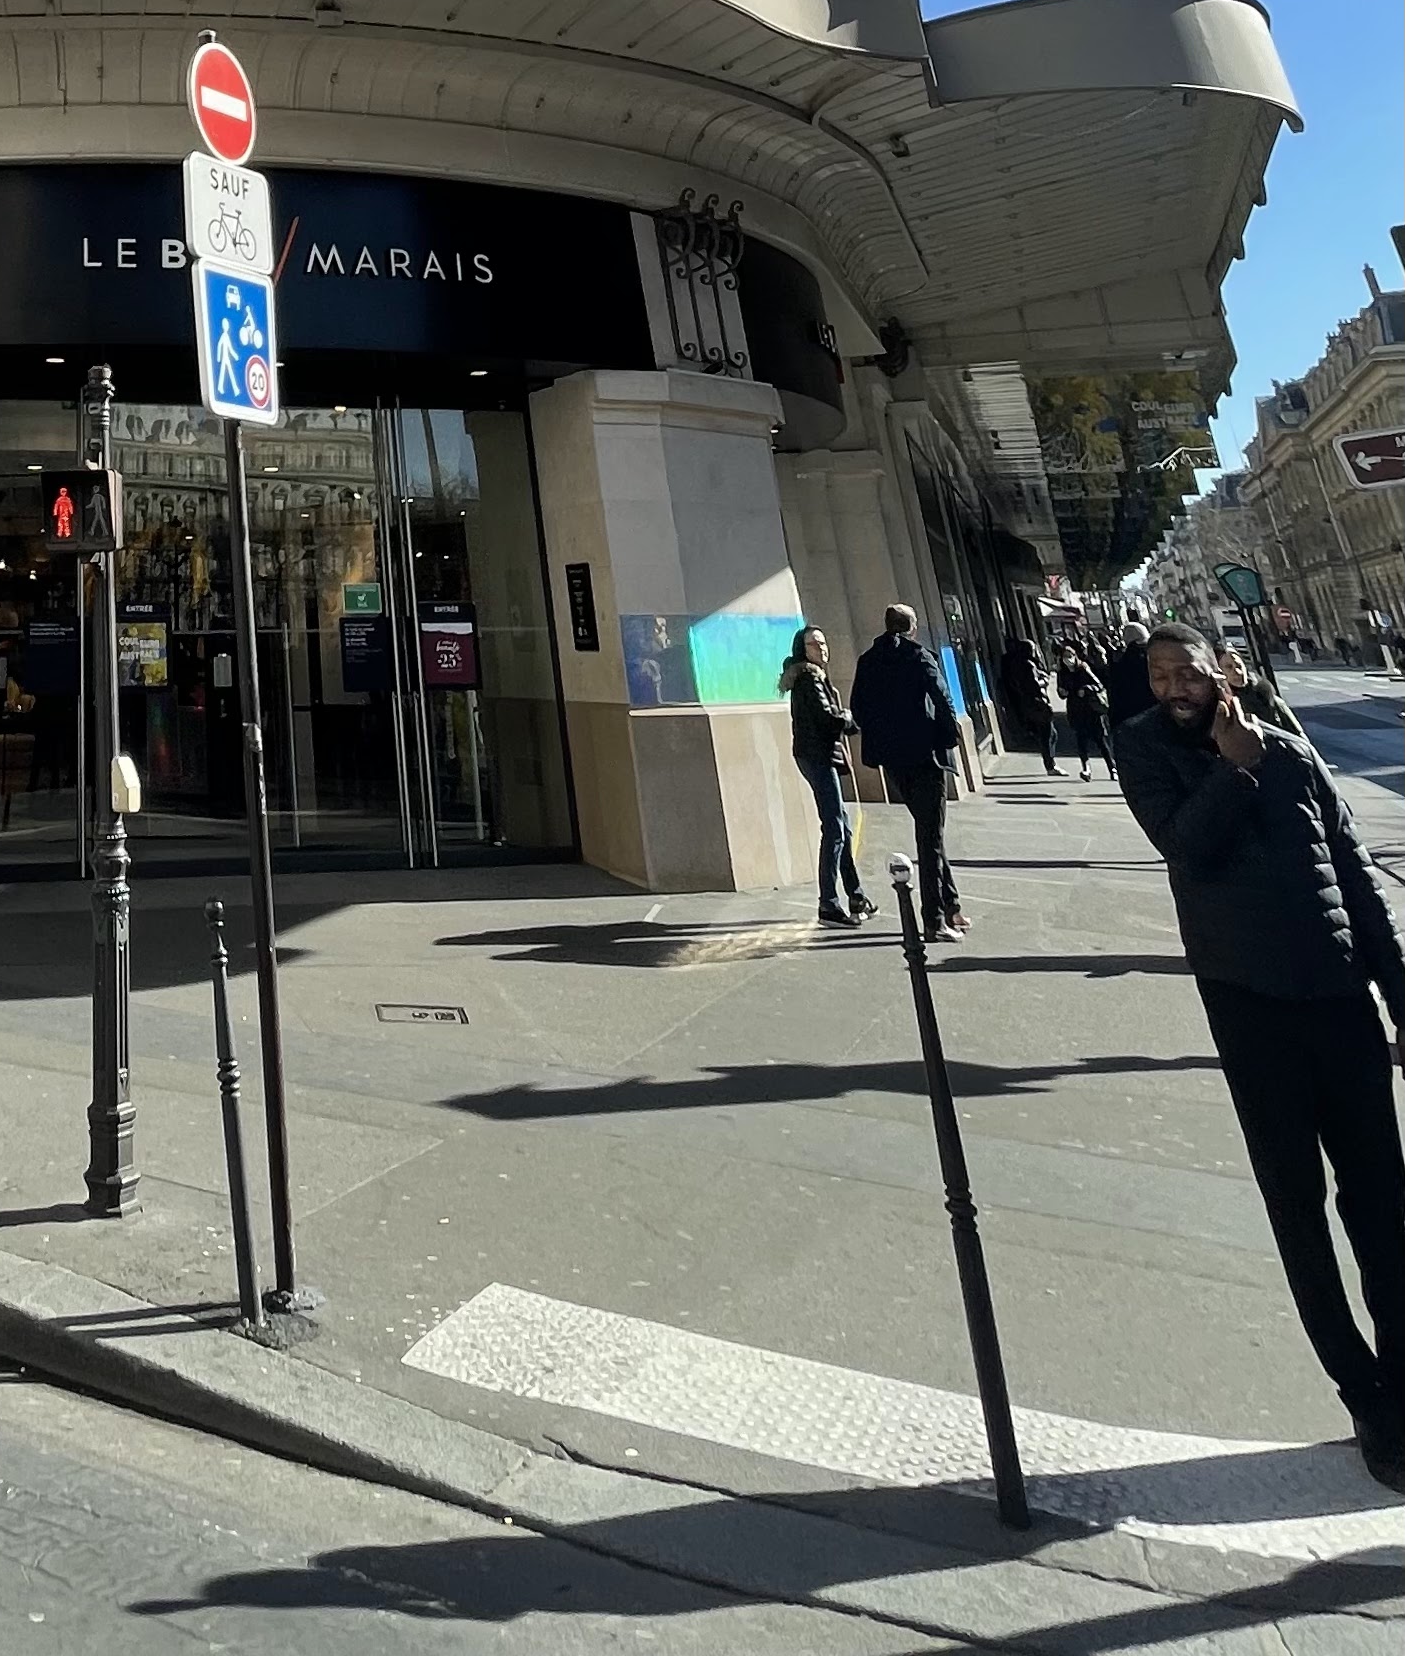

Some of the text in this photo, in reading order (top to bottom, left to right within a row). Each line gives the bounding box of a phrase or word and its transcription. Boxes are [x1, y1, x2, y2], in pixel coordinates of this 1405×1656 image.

[210, 167, 250, 201] SAUF
[82, 238, 137, 268] LE
[306, 242, 494, 284] MARAIS
[251, 371, 265, 391] 20
